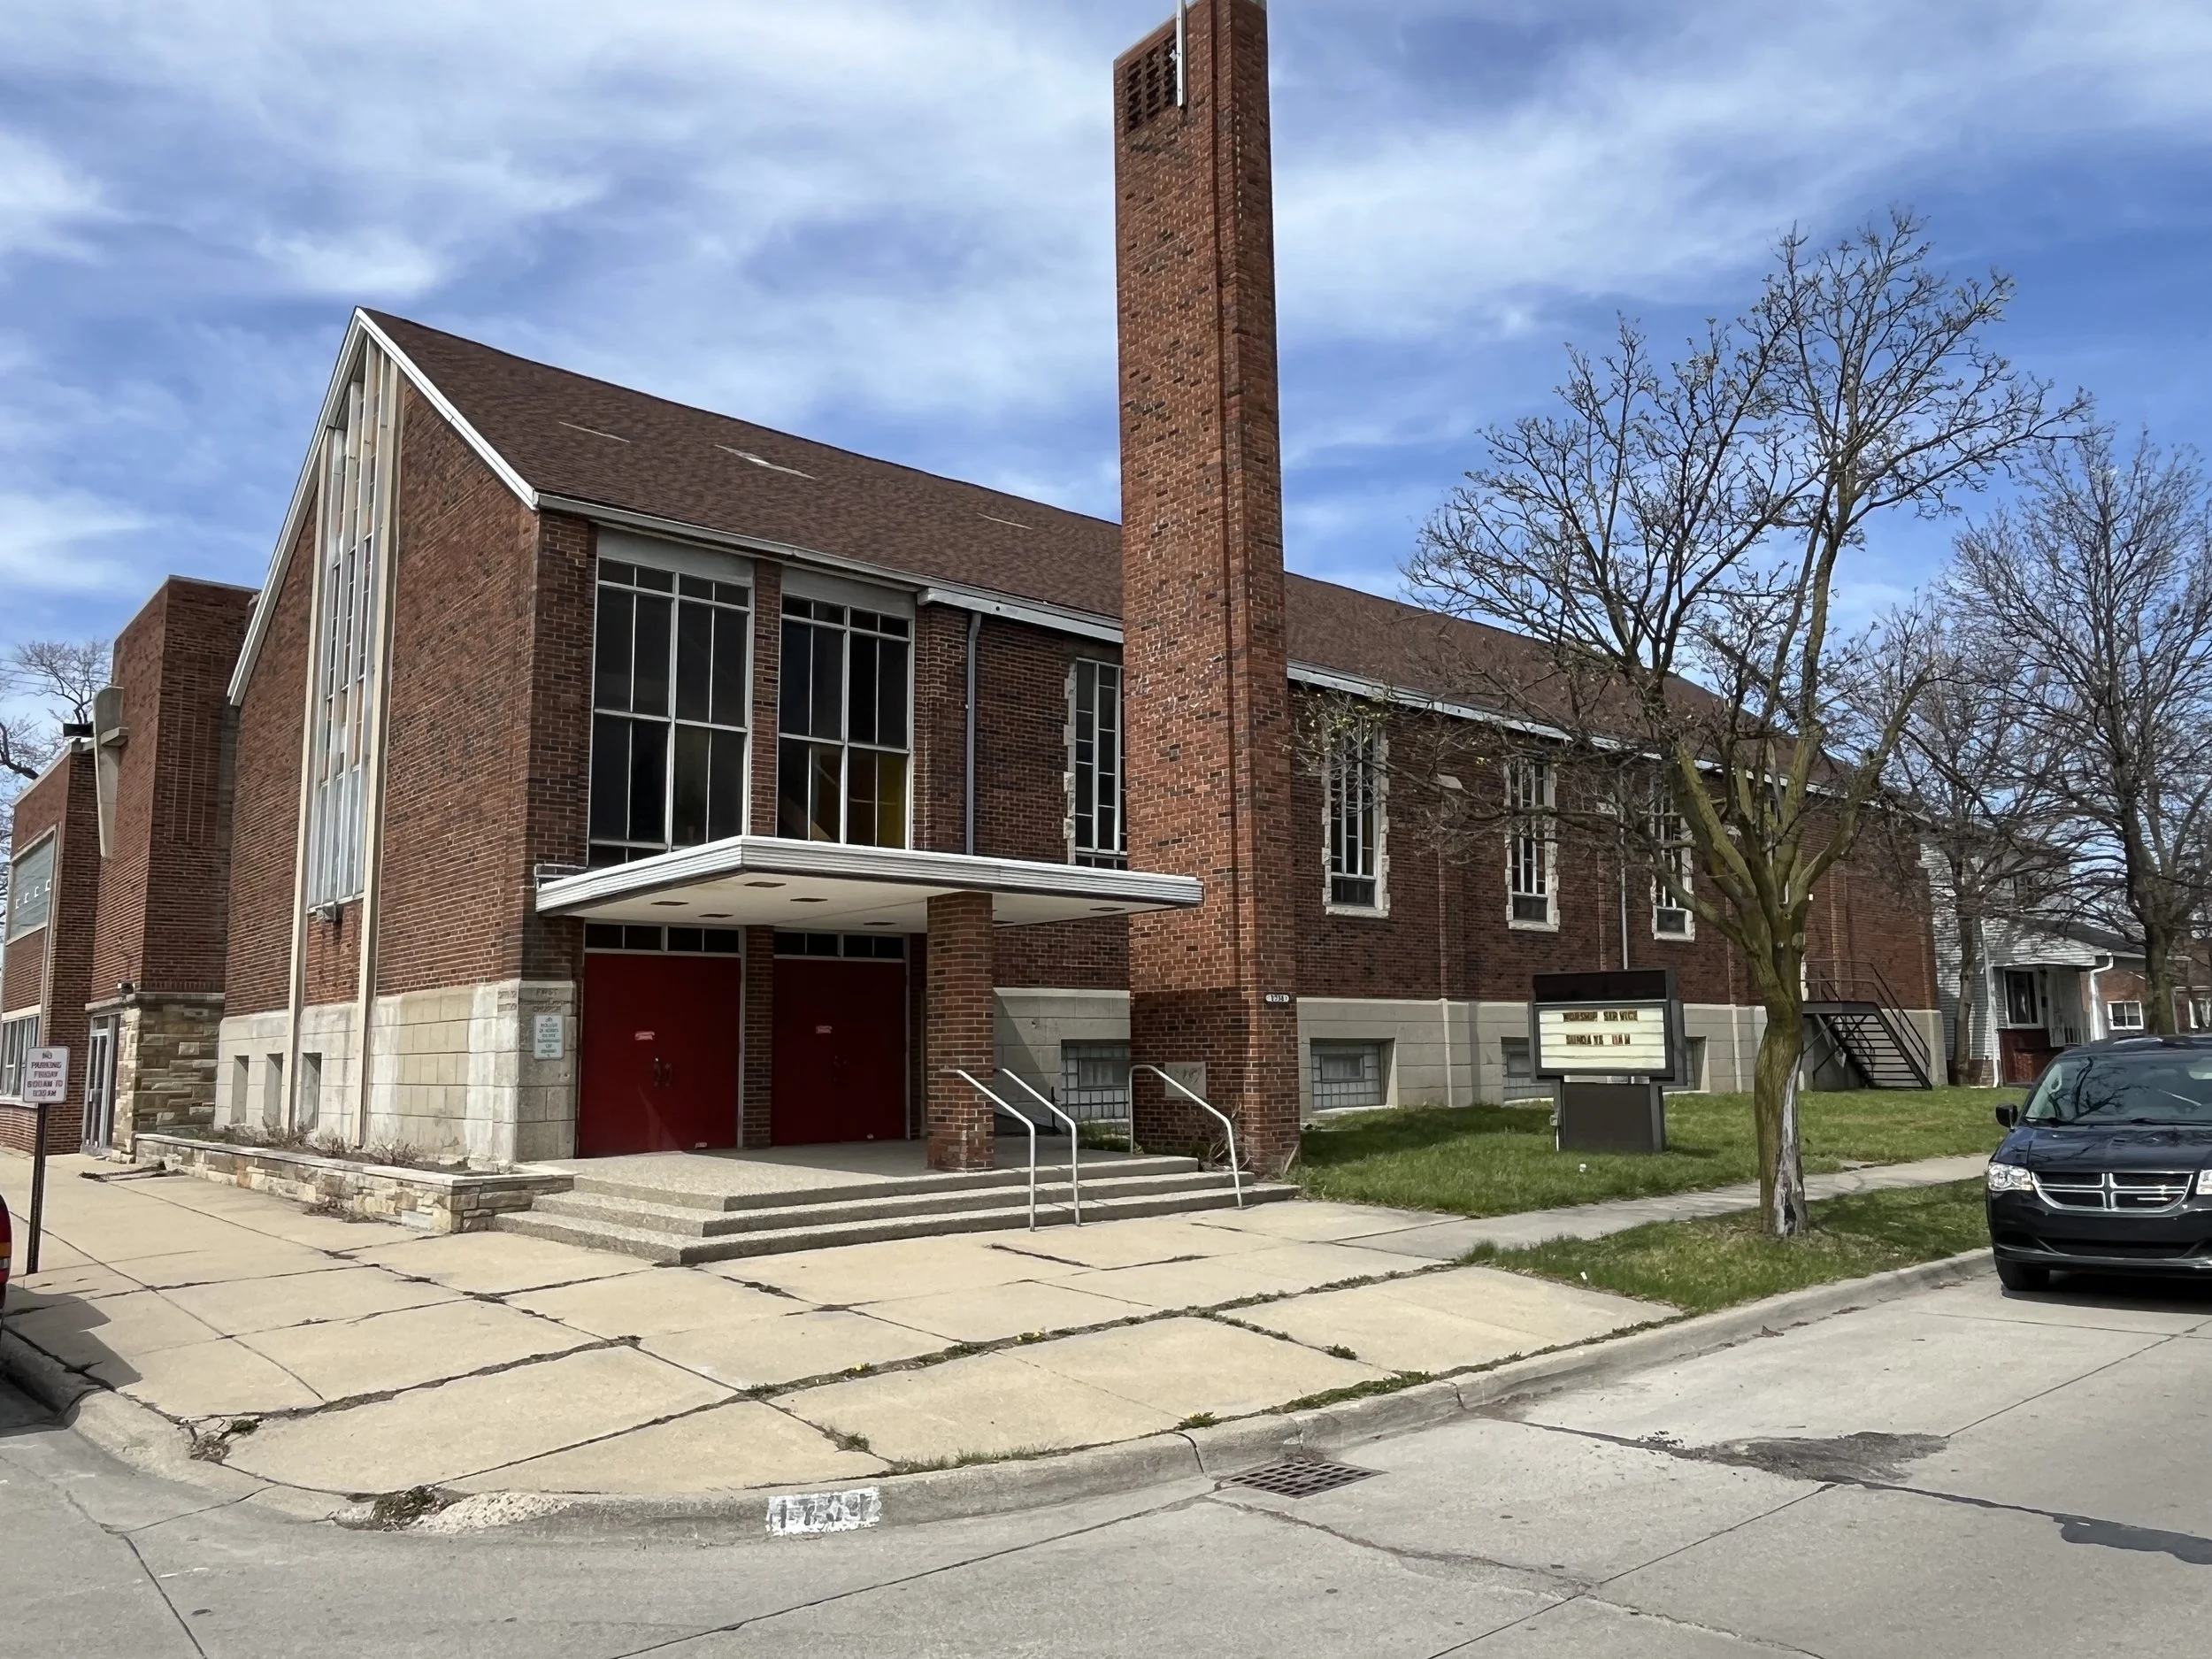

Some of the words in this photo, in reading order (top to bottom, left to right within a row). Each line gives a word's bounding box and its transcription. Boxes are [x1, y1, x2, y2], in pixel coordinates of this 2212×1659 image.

[1563, 1012, 1597, 1022] WORSHIP
[1603, 1010, 1638, 1021] SERVICE
[1566, 1034, 1603, 1045] SUNDAYS
